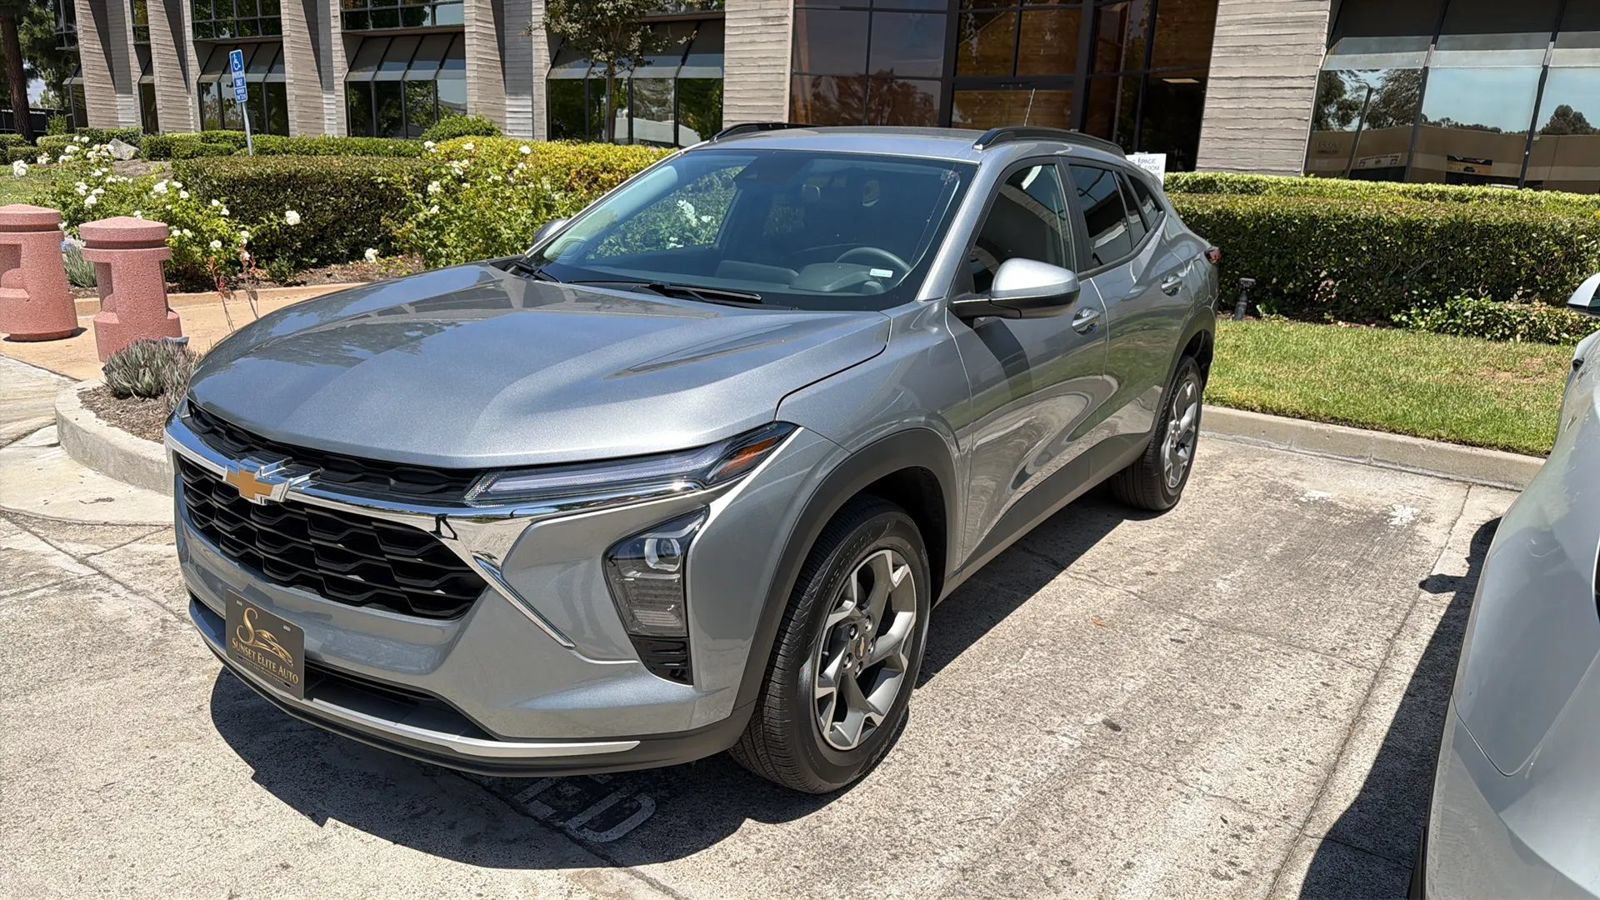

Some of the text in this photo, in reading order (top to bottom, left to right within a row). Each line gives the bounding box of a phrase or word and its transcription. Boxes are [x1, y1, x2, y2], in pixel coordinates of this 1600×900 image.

[231, 638, 256, 661] SUNSET
[257, 653, 277, 672] ELITE
[278, 665, 299, 684] AUTO
